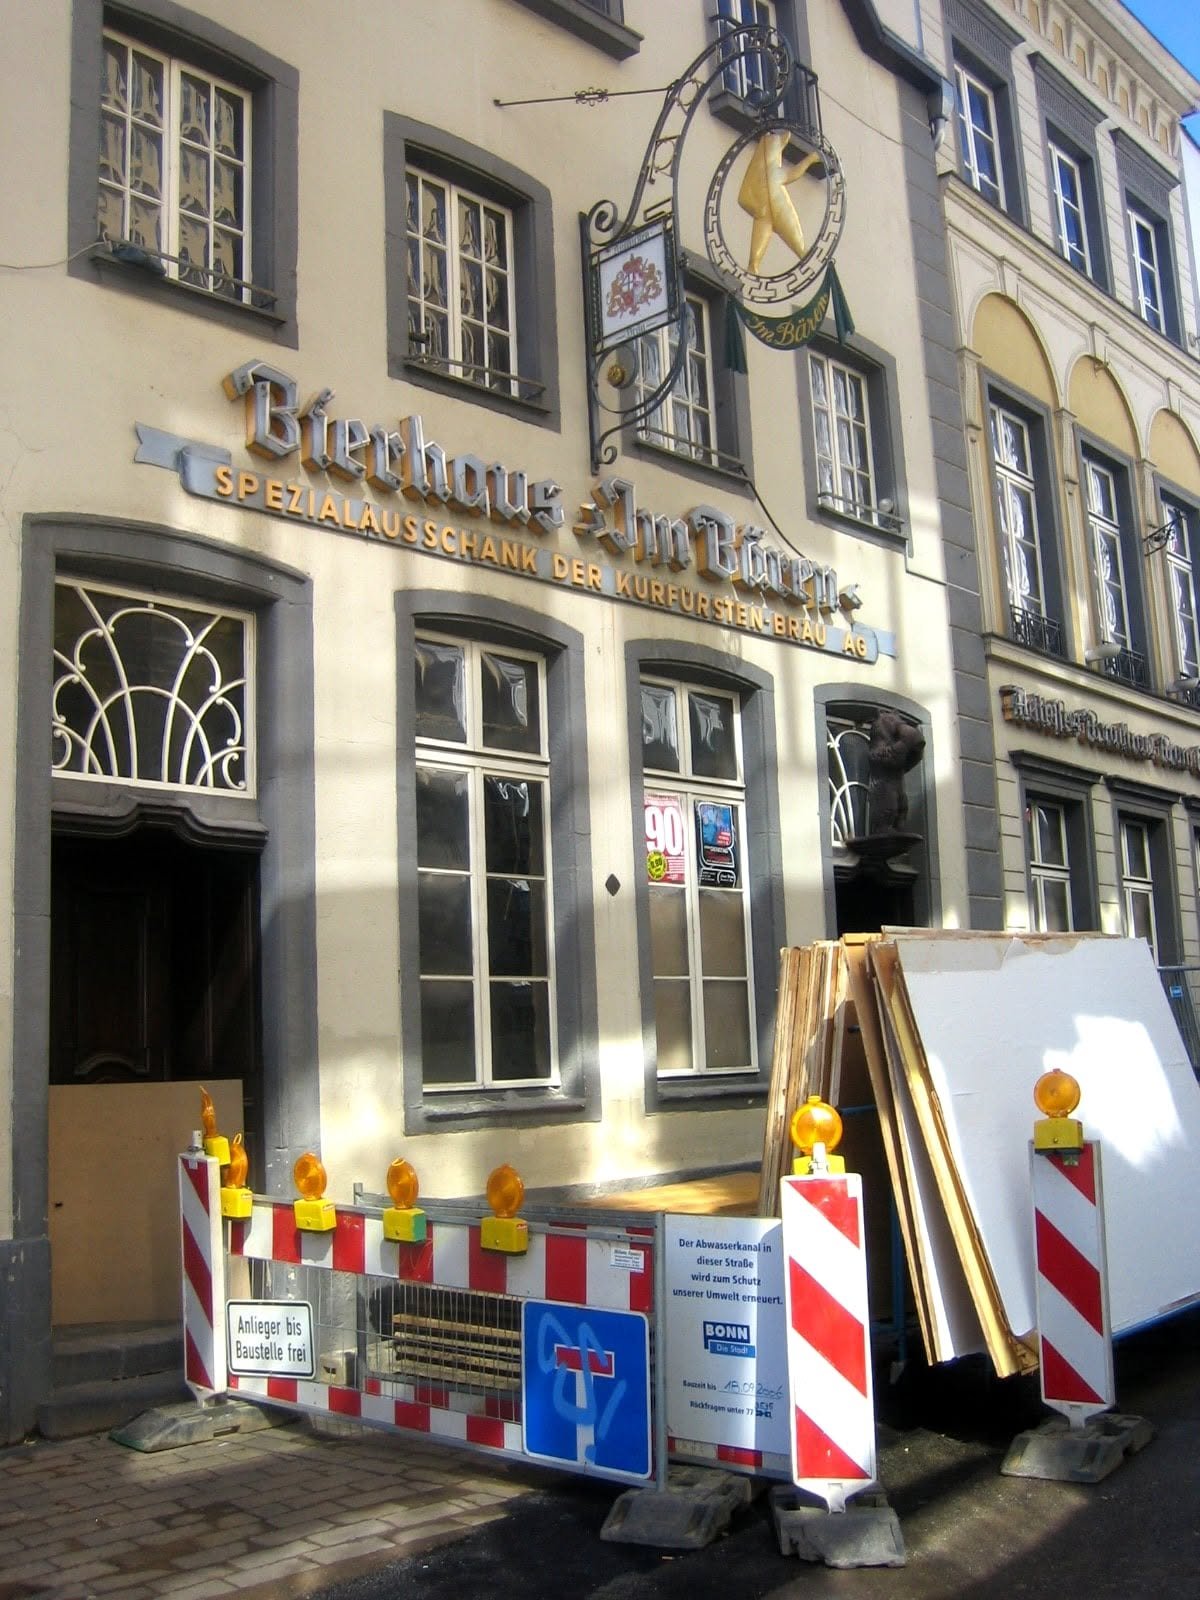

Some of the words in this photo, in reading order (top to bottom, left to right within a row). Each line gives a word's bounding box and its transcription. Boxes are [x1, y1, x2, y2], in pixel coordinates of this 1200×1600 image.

[776, 294, 830, 346] Bären
[222, 358, 564, 536] Bierhaus
[572, 476, 692, 572] Im
[215, 465, 538, 574] SPEZIALAUSSCHANK
[553, 554, 603, 590] DER
[615, 570, 828, 647] KURFÜRSTEN-BRÄU
[842, 630, 868, 658] AG
[679, 1239, 694, 1248] Der
[696, 1239, 761, 1253] Abwasserkanal
[763, 1243, 772, 1253] in
[697, 1256, 723, 1267] dieser
[725, 1258, 754, 1269] Straße
[691, 1272, 711, 1282] wird
[712, 1275, 731, 1284] zum
[733, 1276, 762, 1287] Schutz
[673, 1288, 704, 1298] unserer
[706, 1290, 740, 1302] Umwelt
[742, 1294, 784, 1305] erneuert.
[238, 1315, 281, 1339] Anlieger
[286, 1316, 302, 1337] bis
[706, 1324, 748, 1340] BONN
[236, 1340, 284, 1361] Baustelle
[288, 1343, 306, 1363] frei
[707, 1382, 717, 1391] bis
[727, 1407, 745, 1415] unter
